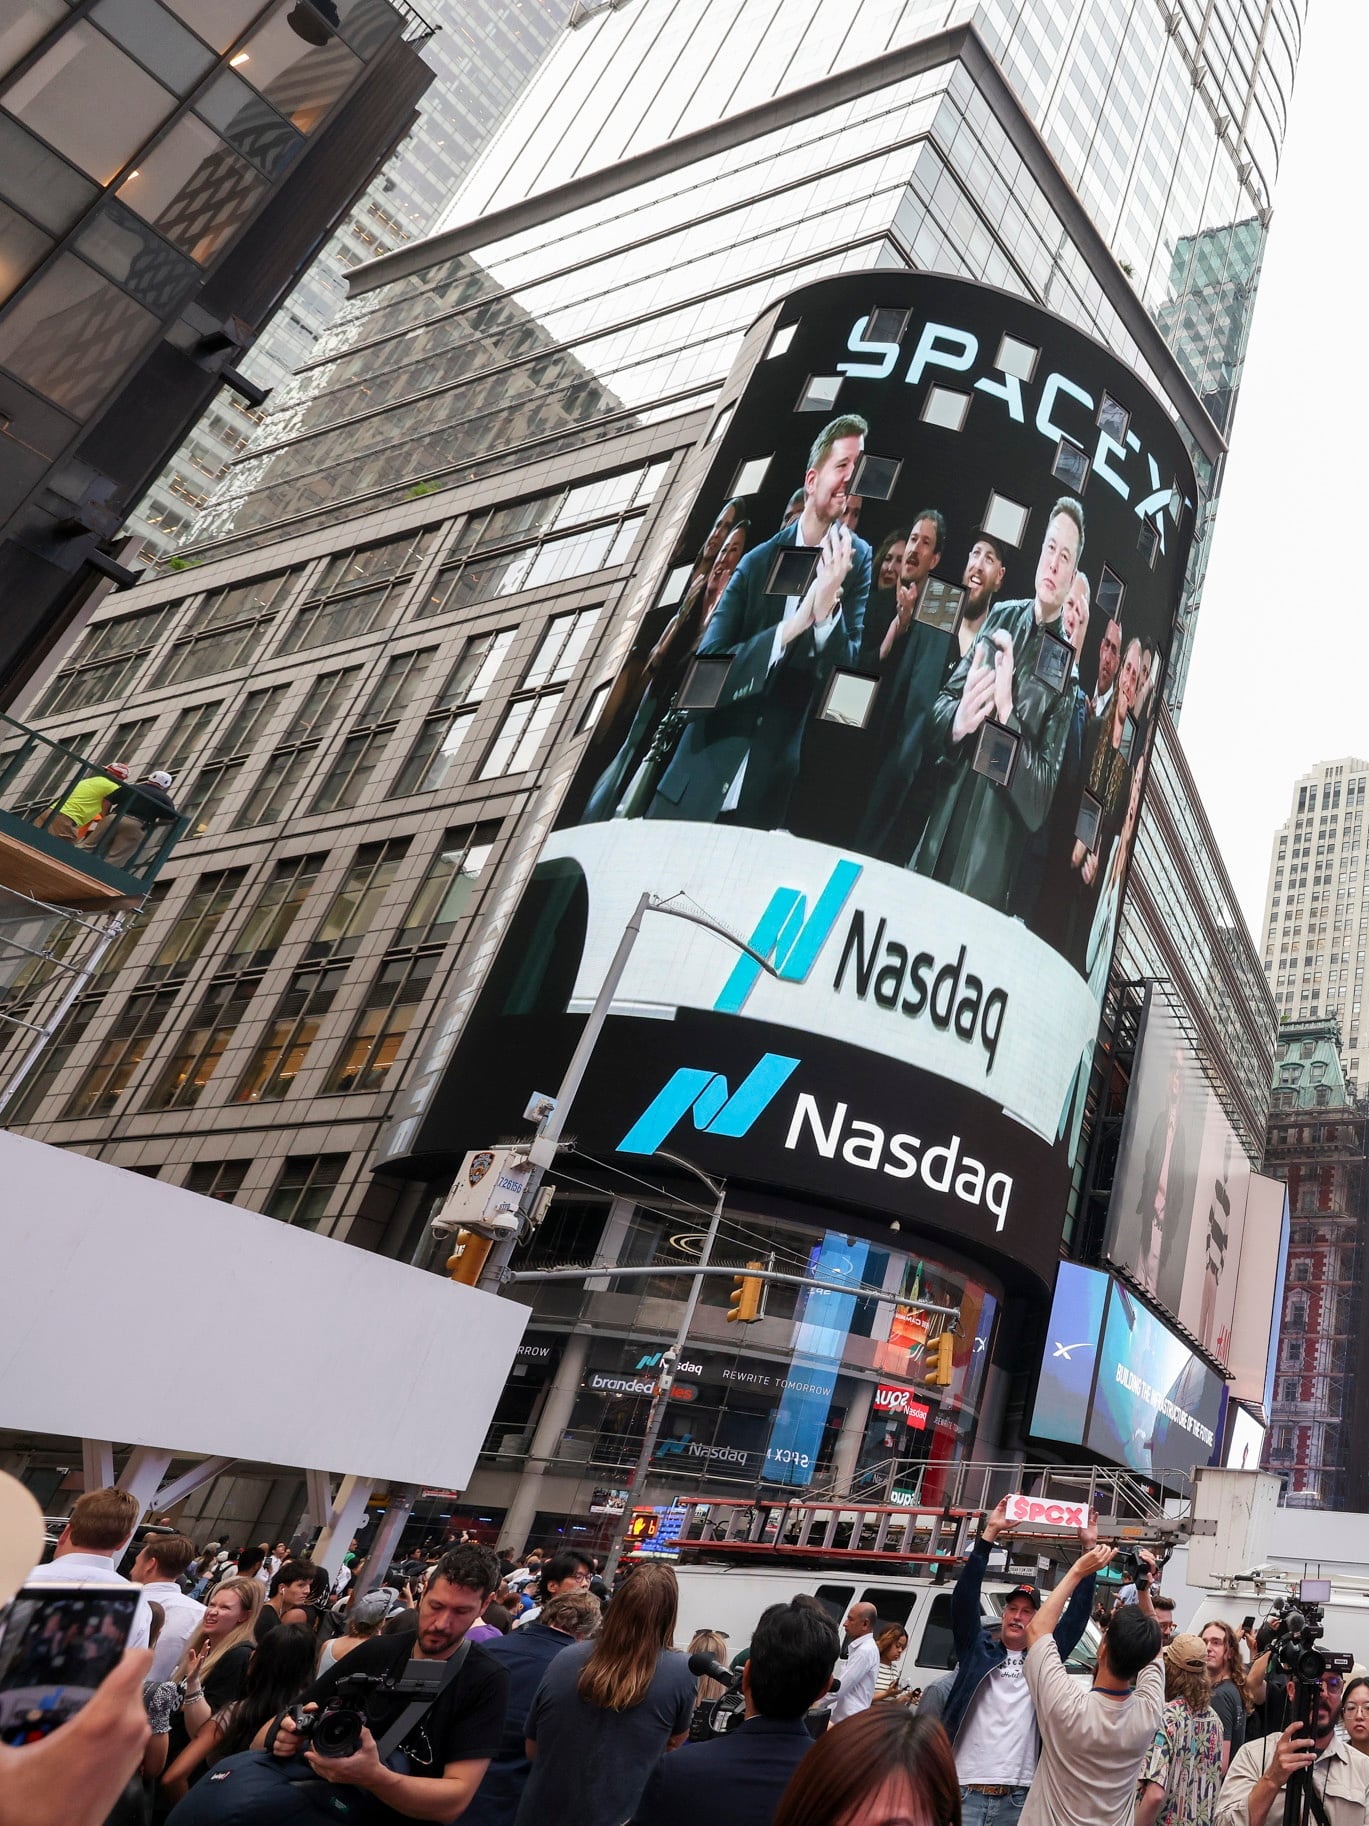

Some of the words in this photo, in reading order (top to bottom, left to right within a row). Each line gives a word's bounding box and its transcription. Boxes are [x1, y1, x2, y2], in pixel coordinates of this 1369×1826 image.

[836, 315, 1192, 555] SPACEX
[833, 909, 1008, 1077] Nasdaq
[784, 1093, 1013, 1232] Nasdaq
[498, 1177, 522, 1193] 726156
[659, 1358, 703, 1375] Nsdaq
[1116, 1363, 1141, 1396] BUILDING
[722, 1369, 770, 1386] REWRITE
[775, 1378, 831, 1396] TOMORROW
[689, 1442, 747, 1466] Nasdaq
